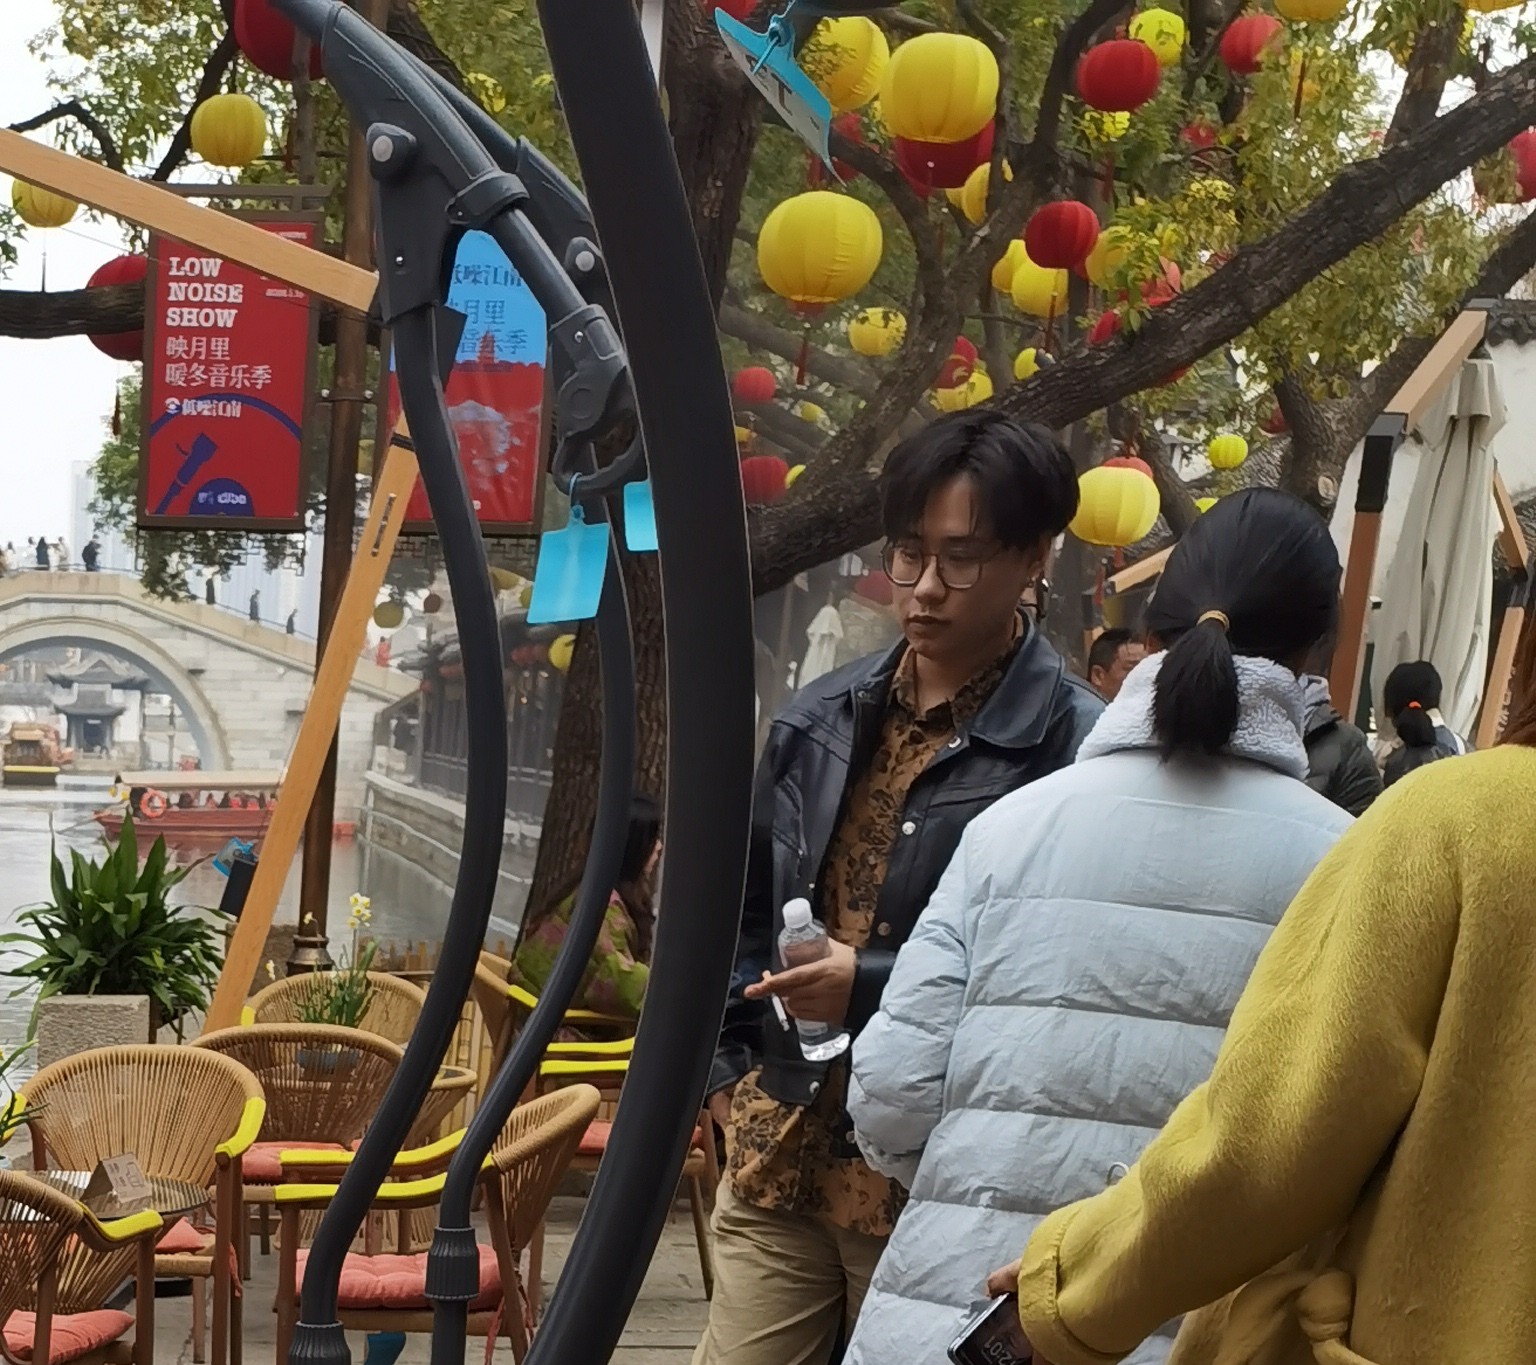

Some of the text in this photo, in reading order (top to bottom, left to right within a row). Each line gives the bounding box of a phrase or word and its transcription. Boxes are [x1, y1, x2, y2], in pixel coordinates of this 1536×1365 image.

[168, 256, 224, 278] LOW
[167, 282, 244, 303] NOISE
[166, 307, 238, 328] SHOW
[165, 335, 231, 361] 映月里
[165, 362, 272, 389] 暖冬音乐季
